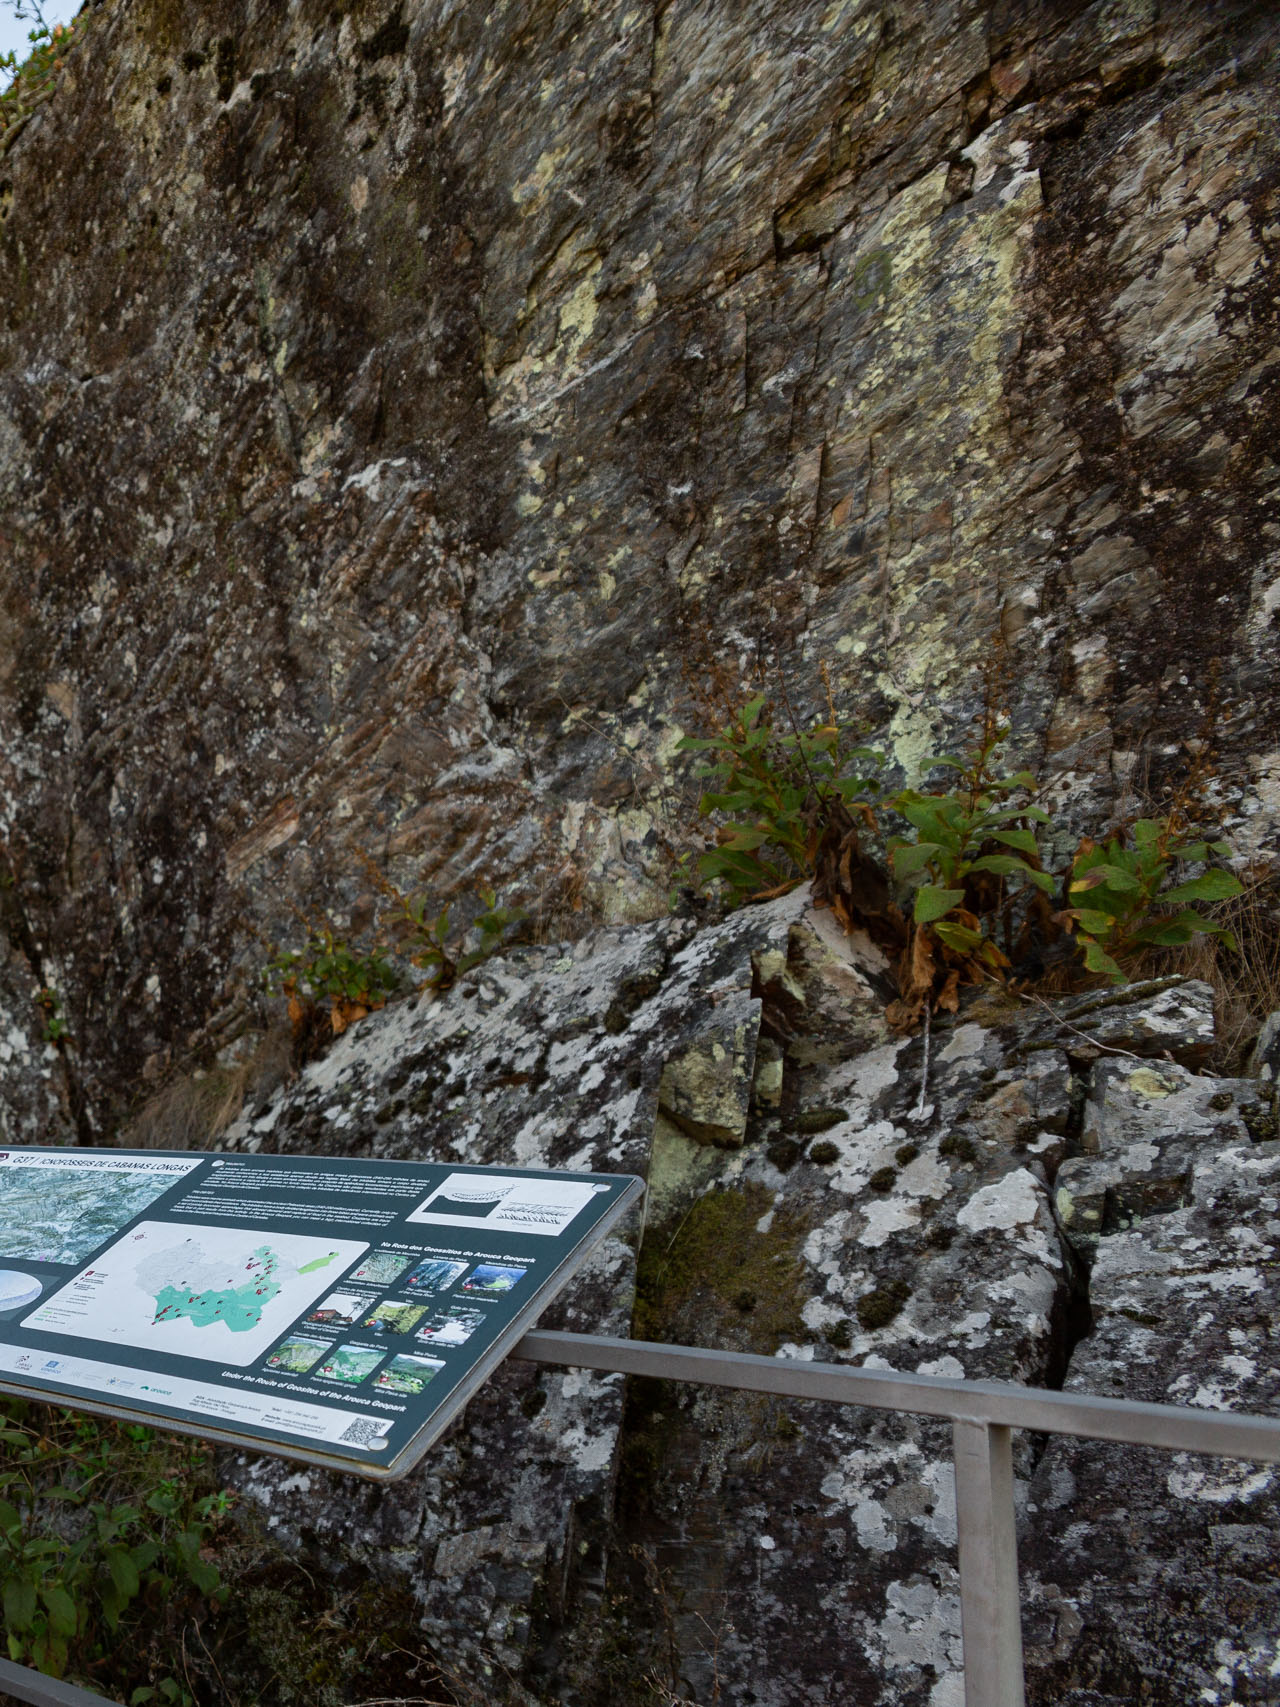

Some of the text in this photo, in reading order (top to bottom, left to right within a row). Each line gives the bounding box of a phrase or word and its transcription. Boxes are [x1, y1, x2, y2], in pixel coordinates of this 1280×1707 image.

[12, 1156, 35, 1164] G37
[94, 1160, 109, 1168] DE
[107, 1161, 152, 1170] CABANAS
[150, 1163, 192, 1172] LONGAS
[423, 1246, 462, 1255] Geossítios
[502, 1254, 536, 1263] Geopark
[221, 1371, 244, 1379] Under
[254, 1377, 278, 1387] Route
[286, 1383, 320, 1395] Geosites
[341, 1395, 372, 1405] Arouca
[371, 1400, 408, 1412] Geopark
